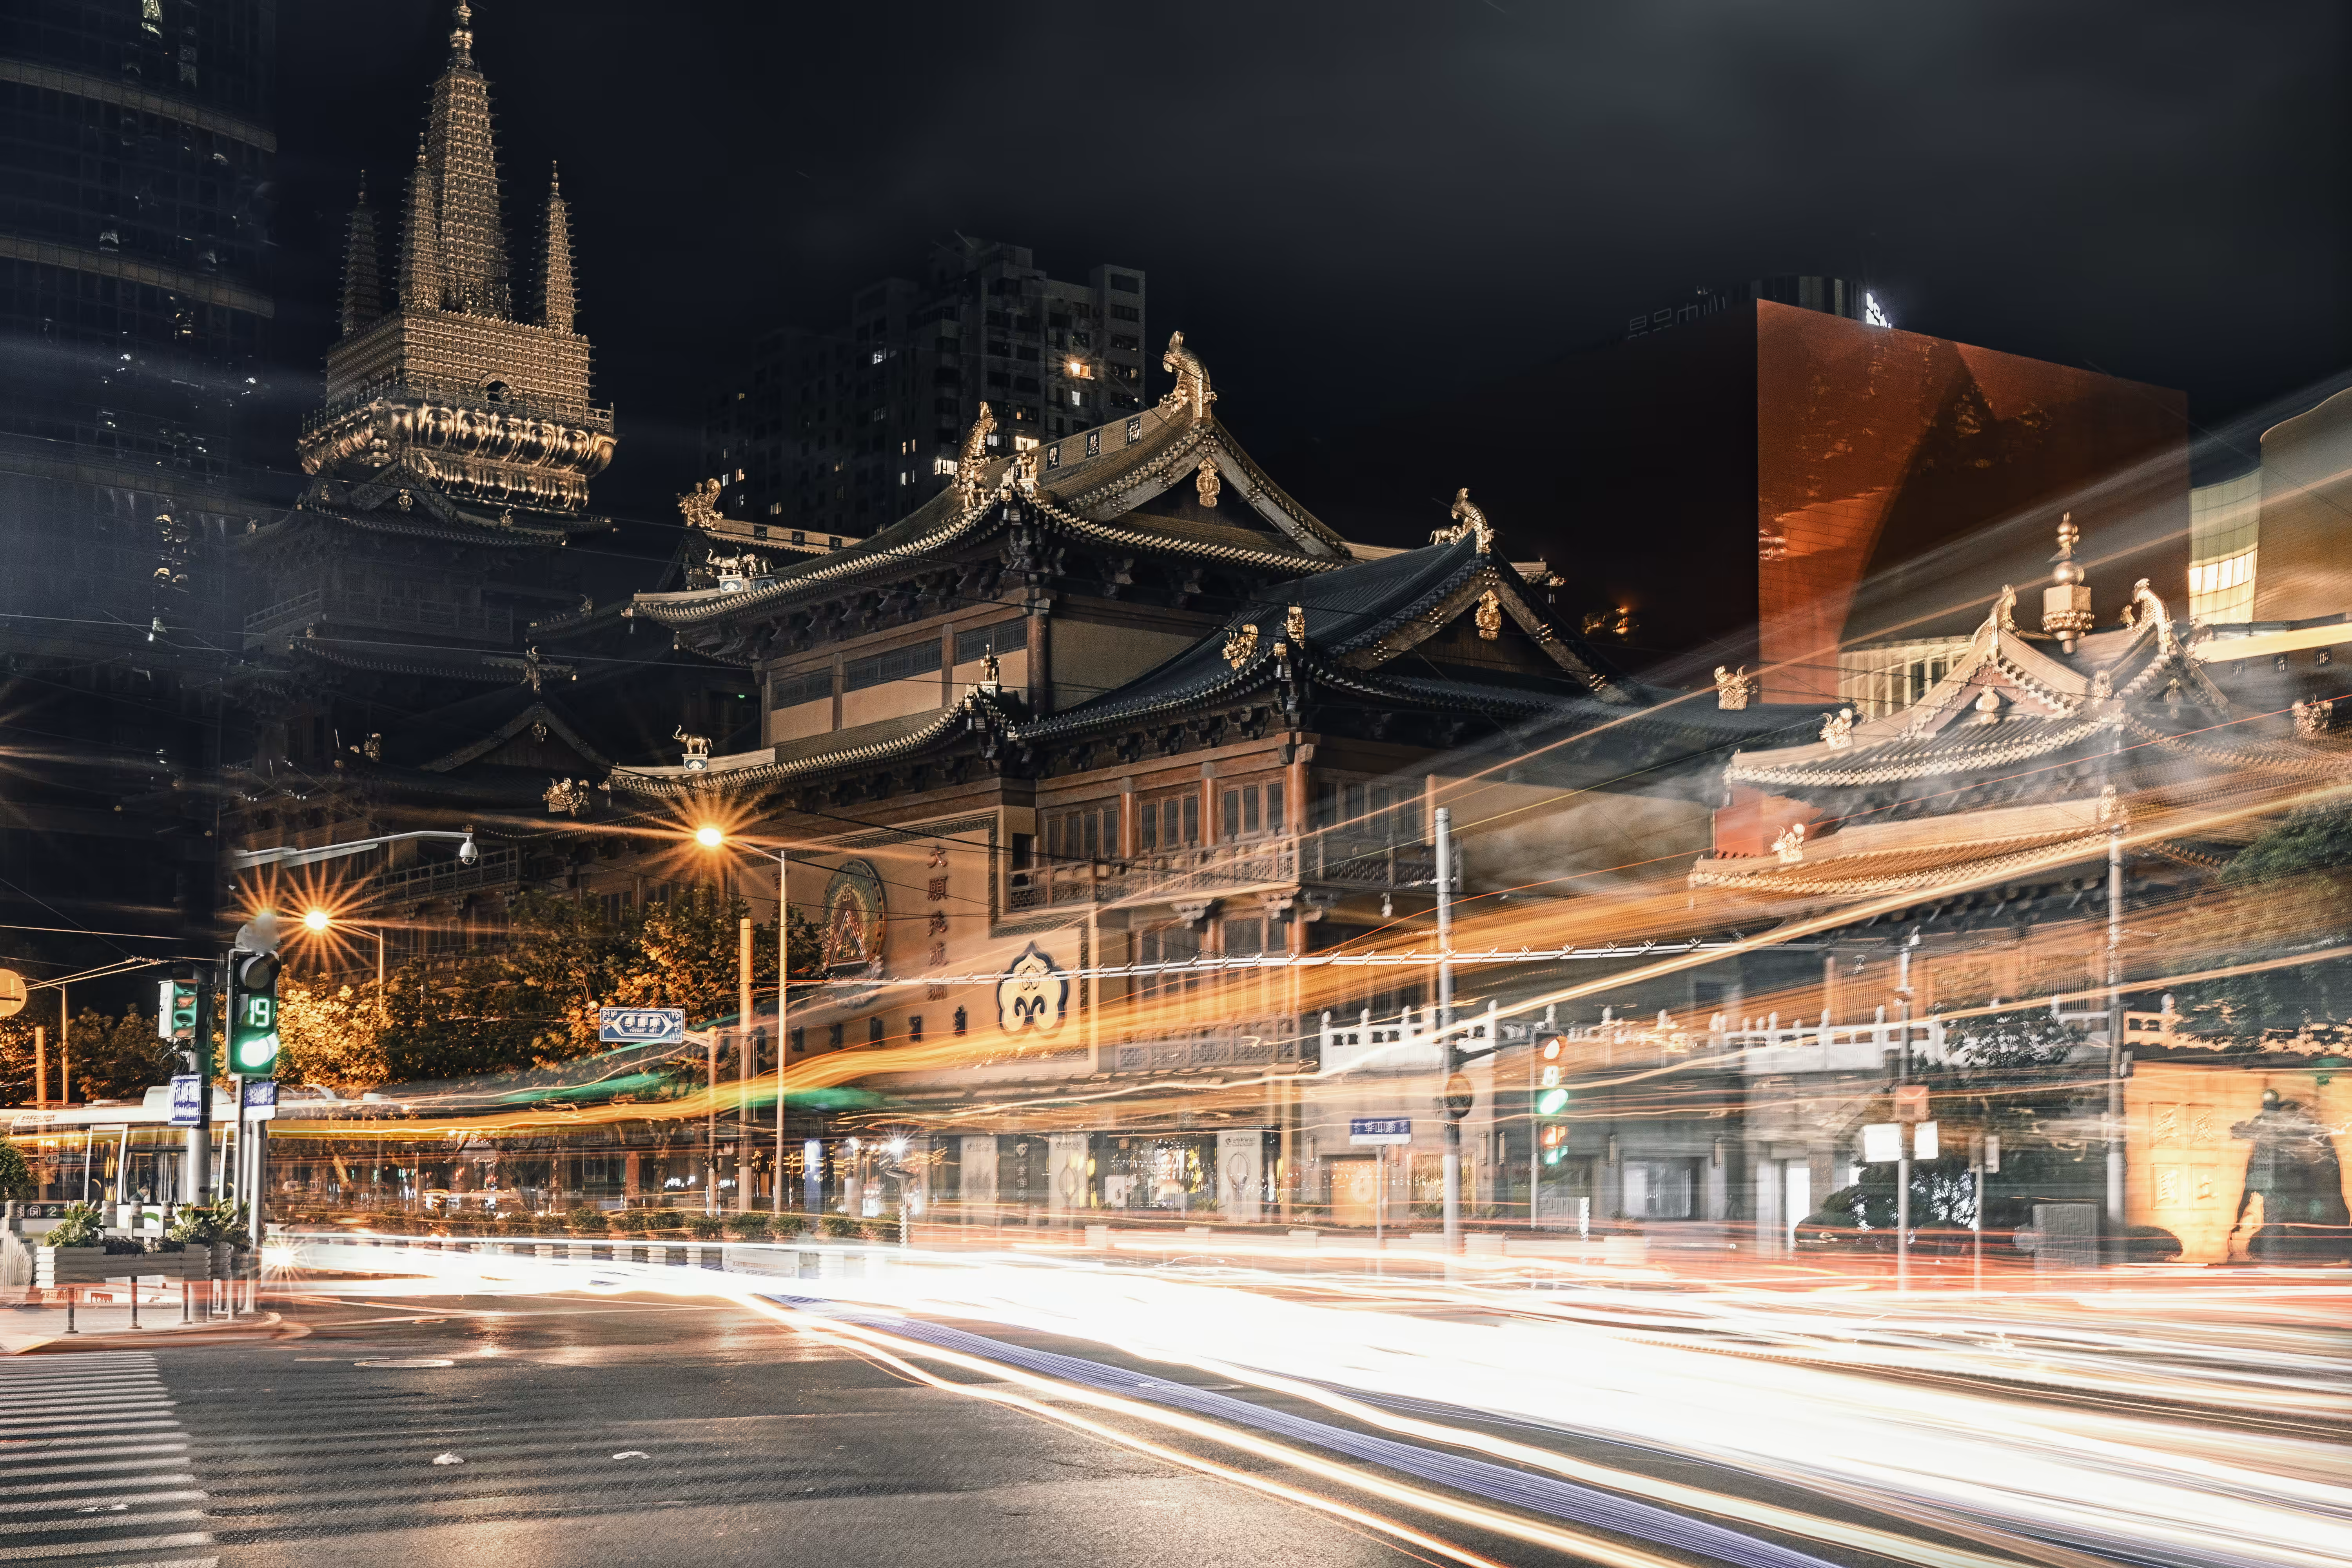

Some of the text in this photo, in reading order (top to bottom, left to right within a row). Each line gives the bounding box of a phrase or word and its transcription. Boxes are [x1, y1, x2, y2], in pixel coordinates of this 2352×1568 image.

[249, 998, 269, 1027] 19
[1365, 1120, 1396, 1134] 华山路
[50, 1206, 56, 1216] 2
